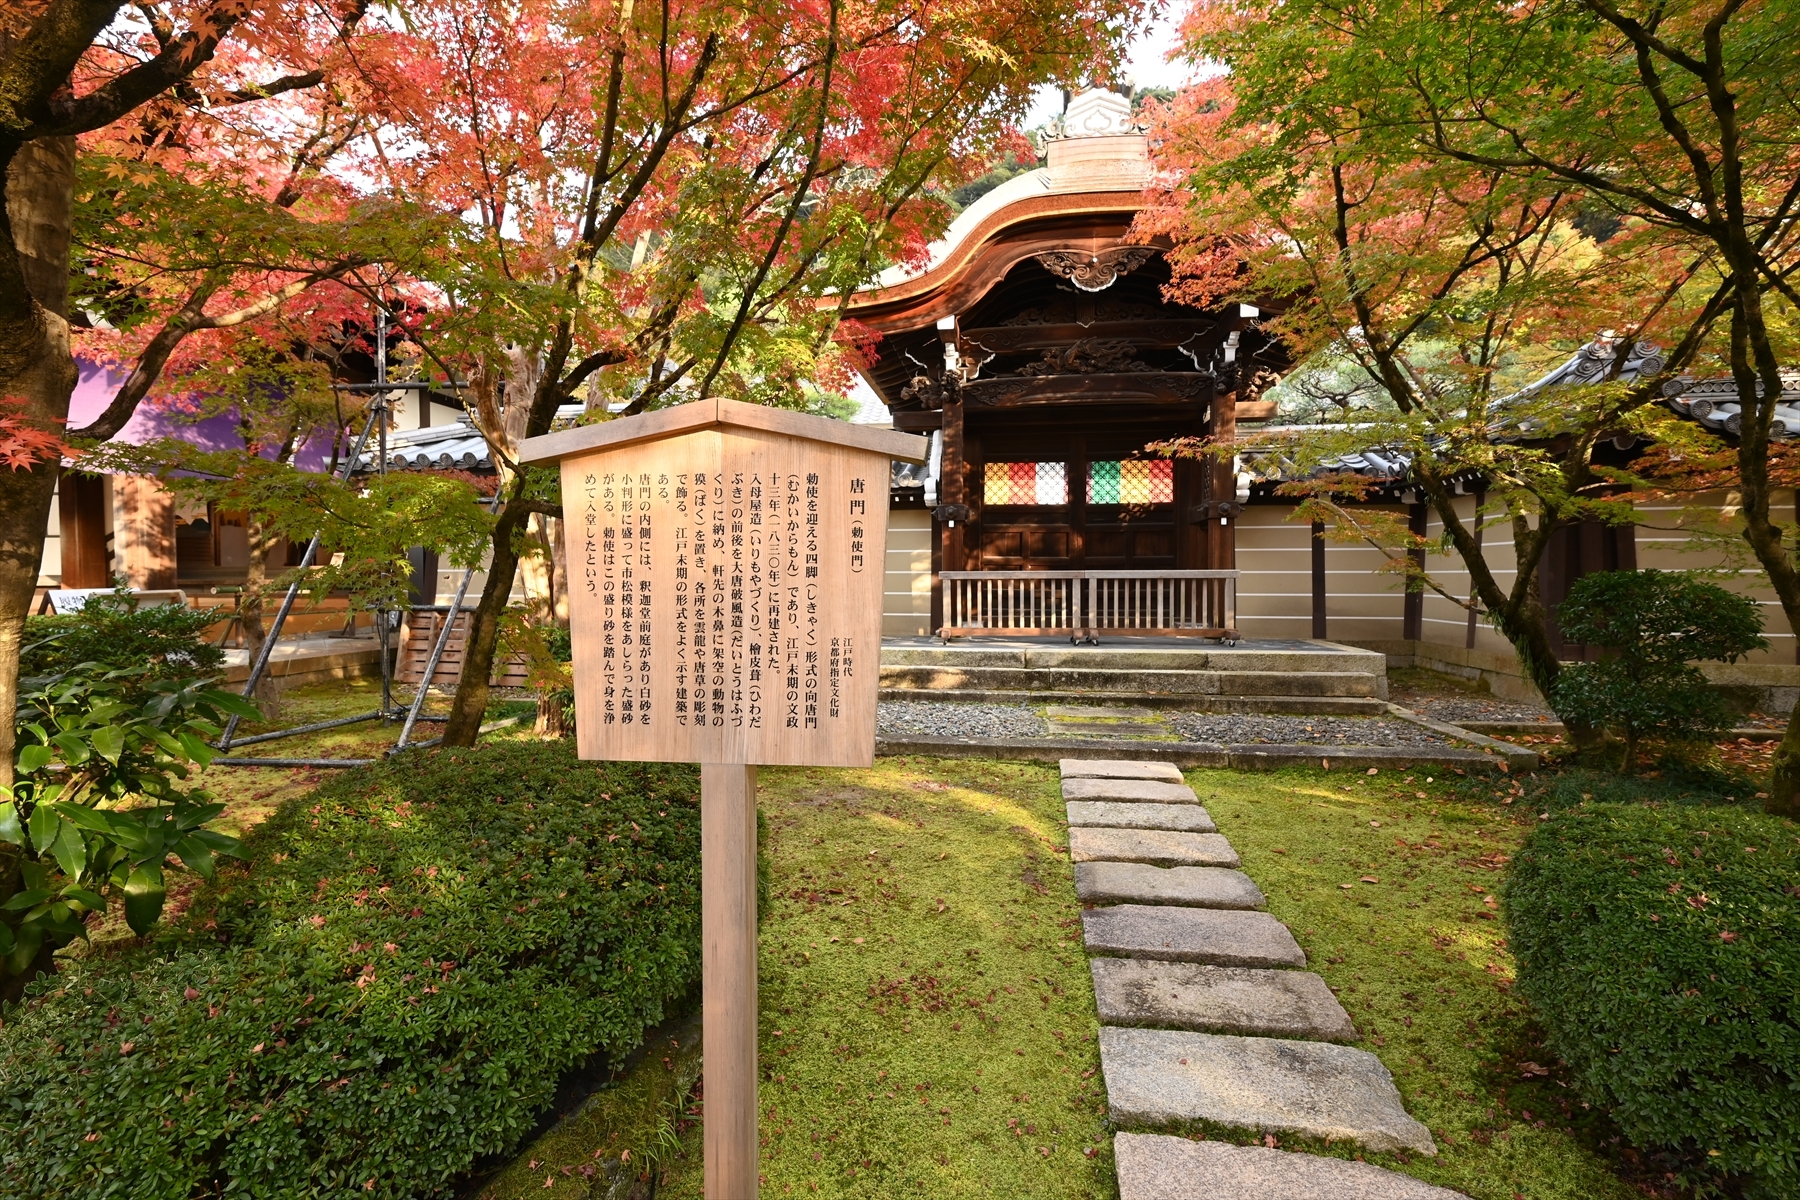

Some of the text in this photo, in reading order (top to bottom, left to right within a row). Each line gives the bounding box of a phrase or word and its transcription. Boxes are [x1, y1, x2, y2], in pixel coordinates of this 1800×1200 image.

[658, 473, 670, 504] ある。
[850, 477, 866, 574] 唐門（勅使門）
[829, 636, 841, 719] 京都府指定文化財
[842, 636, 854, 678] 江戸時代
